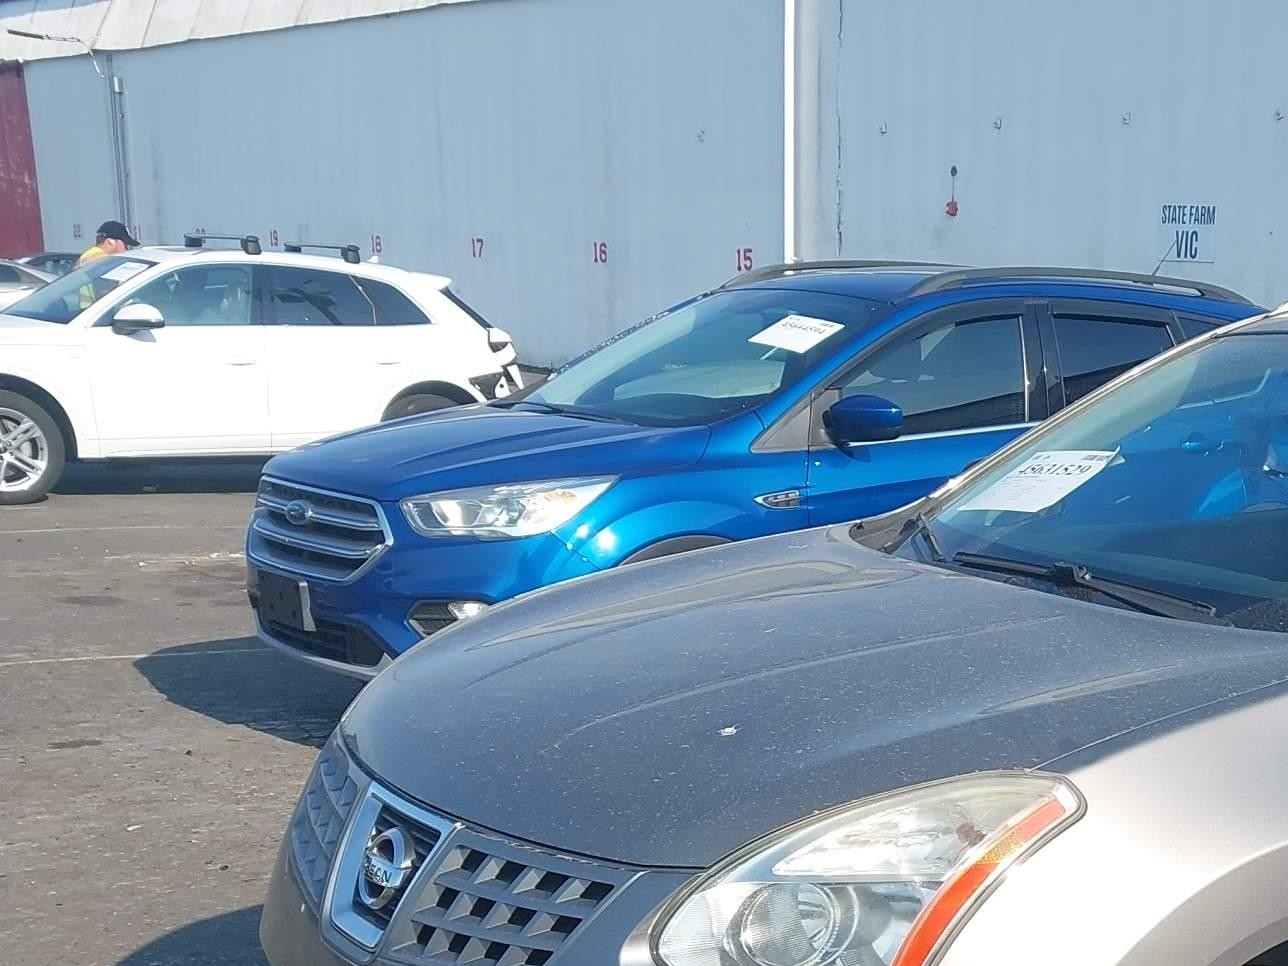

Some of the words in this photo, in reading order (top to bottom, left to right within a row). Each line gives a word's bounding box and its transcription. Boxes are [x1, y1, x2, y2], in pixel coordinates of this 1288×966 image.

[1161, 204, 1187, 225] STATE
[1188, 205, 1216, 225] FARM
[370, 233, 383, 254] 18
[471, 237, 485, 258] 17
[592, 241, 608, 264] 16
[1175, 230, 1199, 259] VIC
[736, 247, 753, 272] 15
